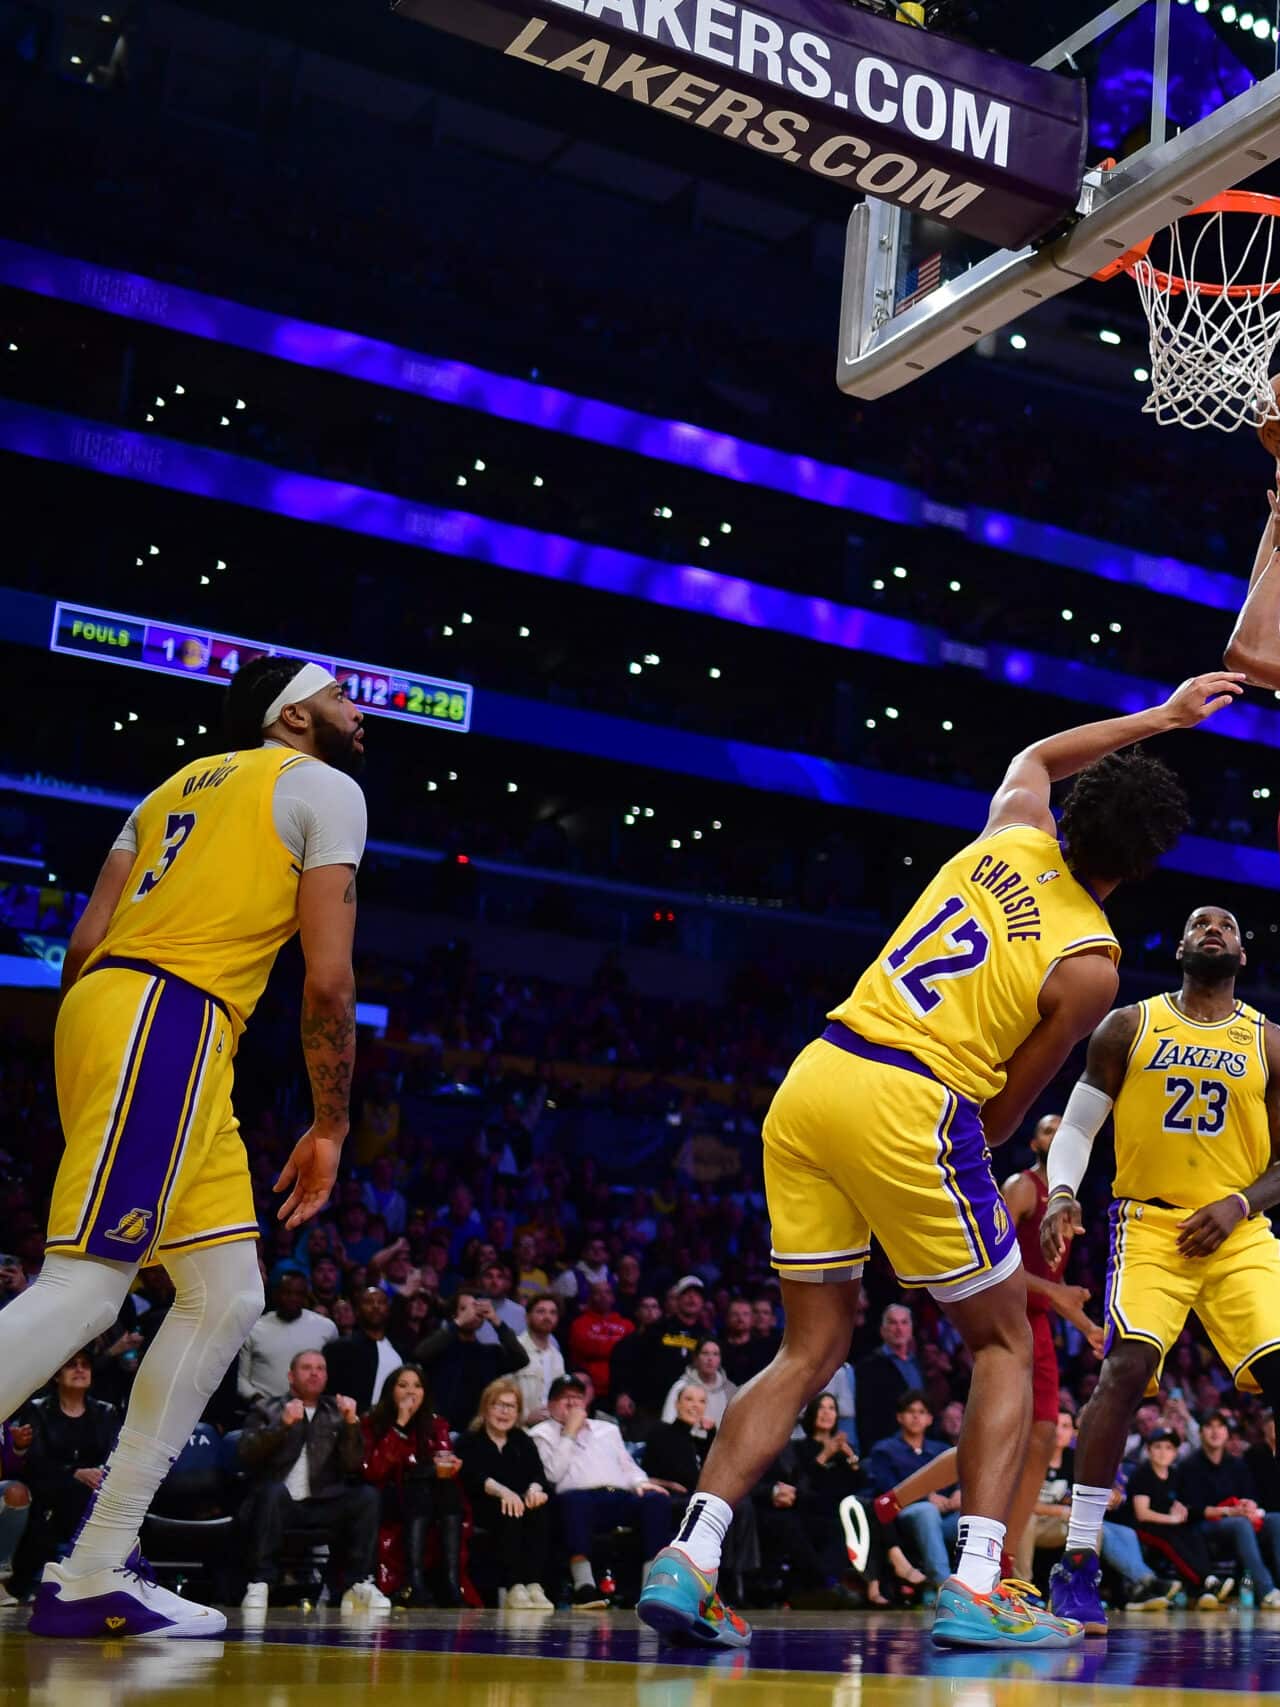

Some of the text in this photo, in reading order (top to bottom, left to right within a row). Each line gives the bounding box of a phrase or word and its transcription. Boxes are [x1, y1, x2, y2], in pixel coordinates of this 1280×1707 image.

[545, 0, 1011, 168] KERS.COM
[503, 17, 985, 219] LAKERS.COM
[72, 620, 130, 648] FOULS
[162, 637, 175, 662] 1
[221, 649, 240, 674] 4
[407, 686, 465, 721] 2:28
[131, 810, 197, 903] 3
[970, 854, 1041, 943] CHRISTIE
[880, 895, 991, 1018] 12
[1144, 1038, 1249, 1079] LAKERS
[1161, 1075, 1229, 1138] 23
